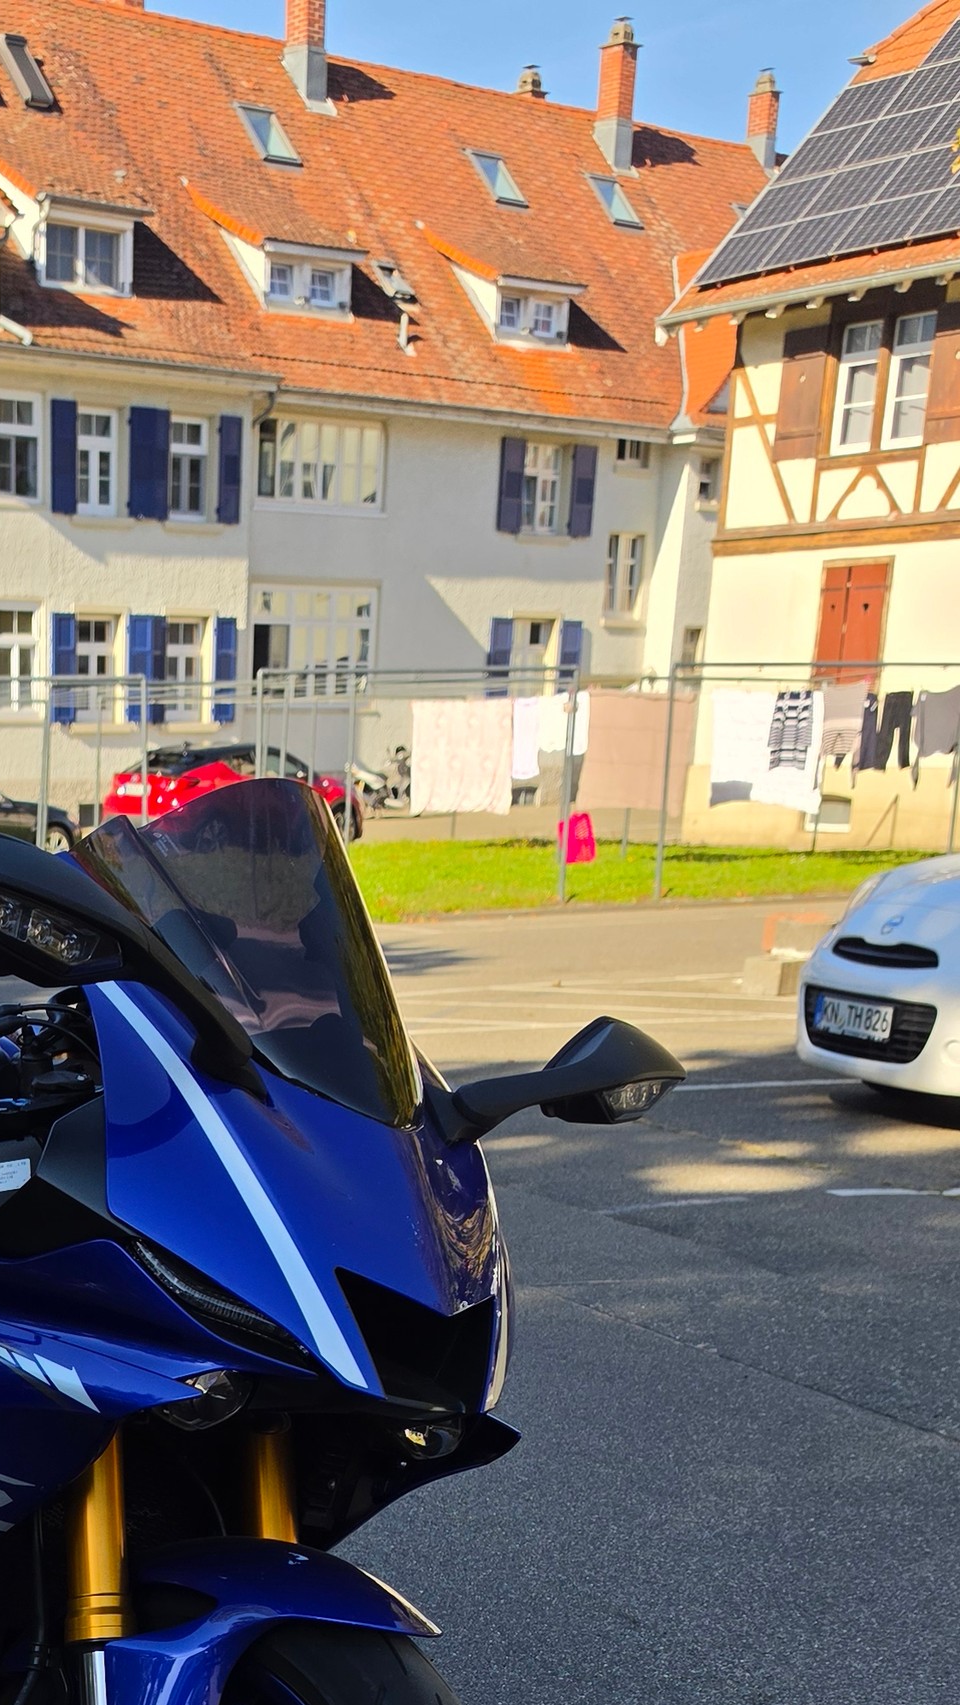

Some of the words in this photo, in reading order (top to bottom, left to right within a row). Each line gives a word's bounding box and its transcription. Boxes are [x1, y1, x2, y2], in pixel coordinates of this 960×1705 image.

[823, 1001, 840, 1025] KN
[847, 1005, 864, 1029] TH
[864, 1008, 889, 1033] 826
